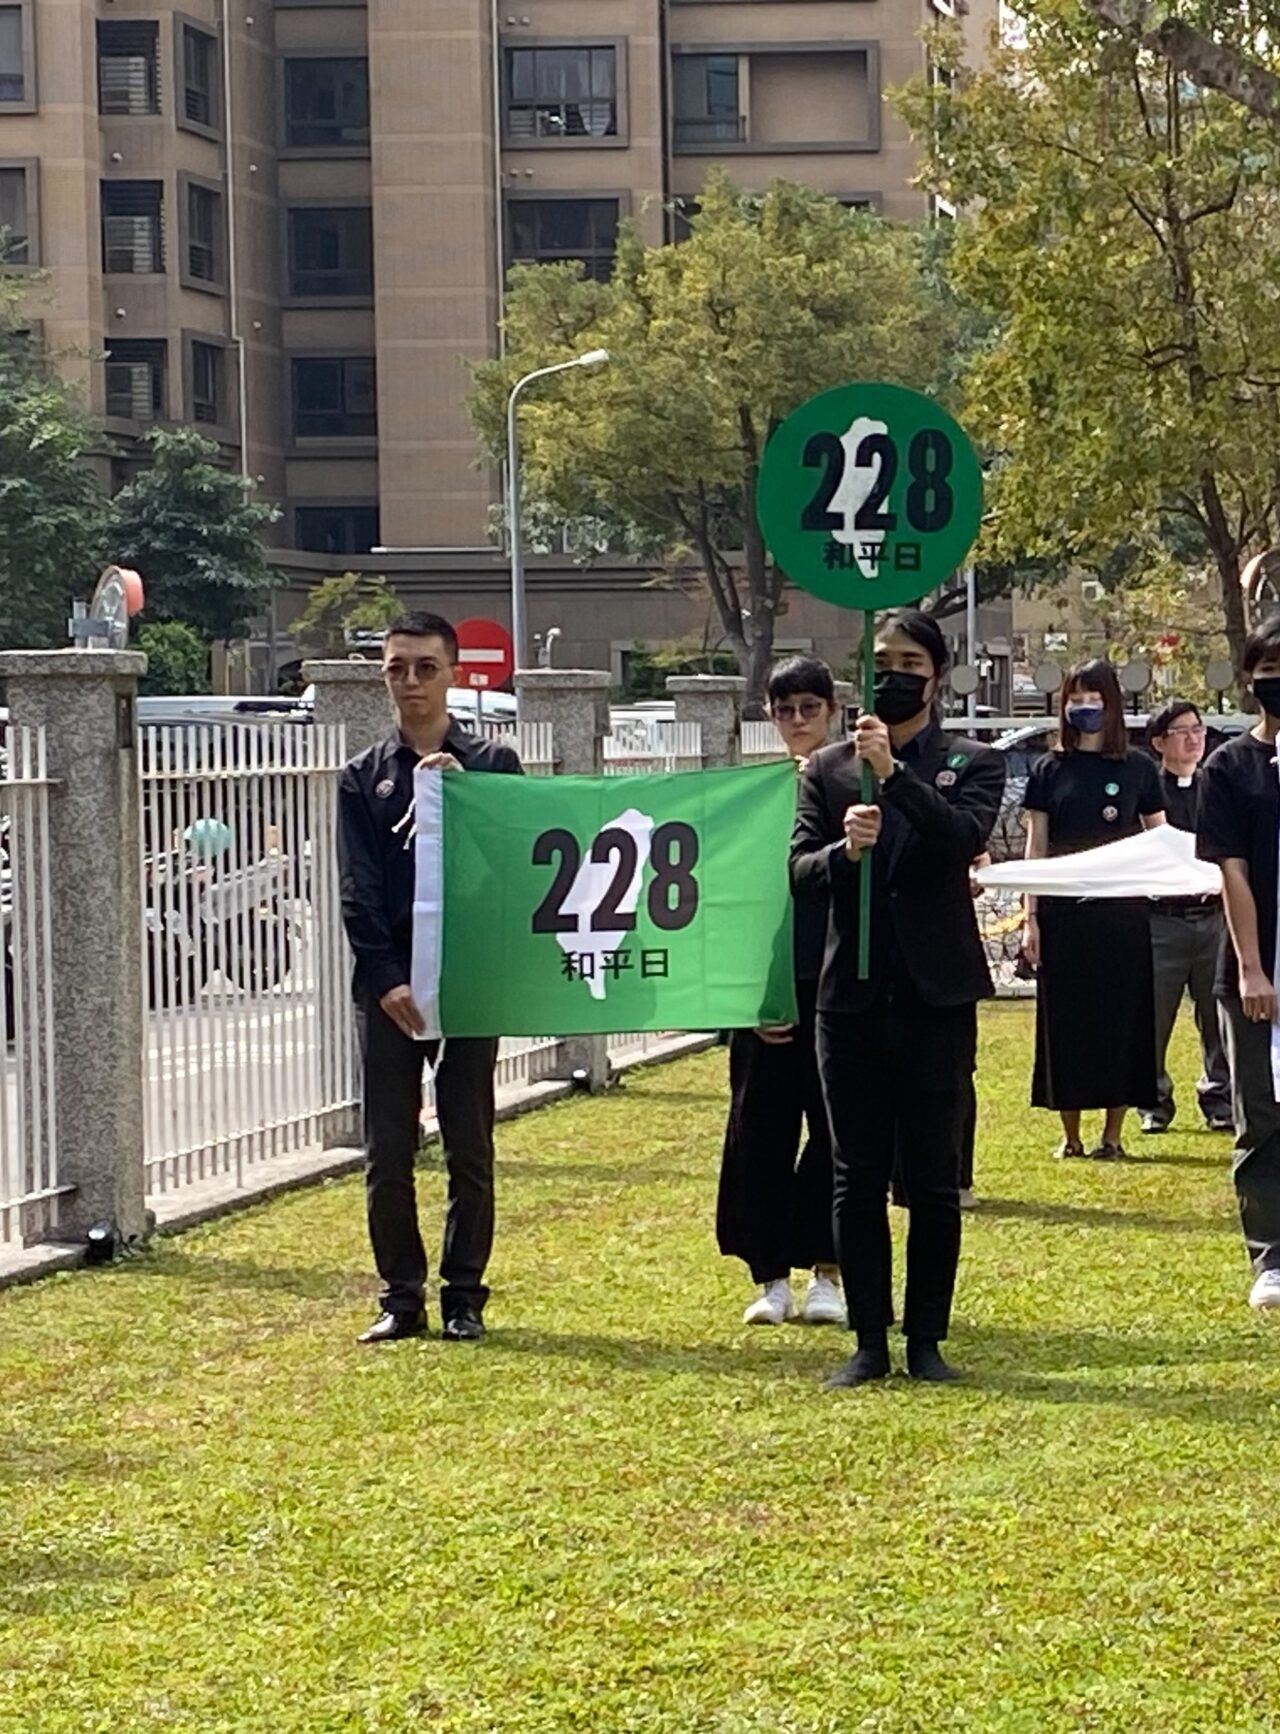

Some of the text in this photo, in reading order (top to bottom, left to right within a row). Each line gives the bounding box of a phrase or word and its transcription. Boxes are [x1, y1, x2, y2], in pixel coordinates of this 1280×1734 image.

[801, 428, 953, 533] 228
[823, 541, 921, 571] 和平日
[532, 821, 699, 934] 228
[561, 948, 669, 981] 和平日
